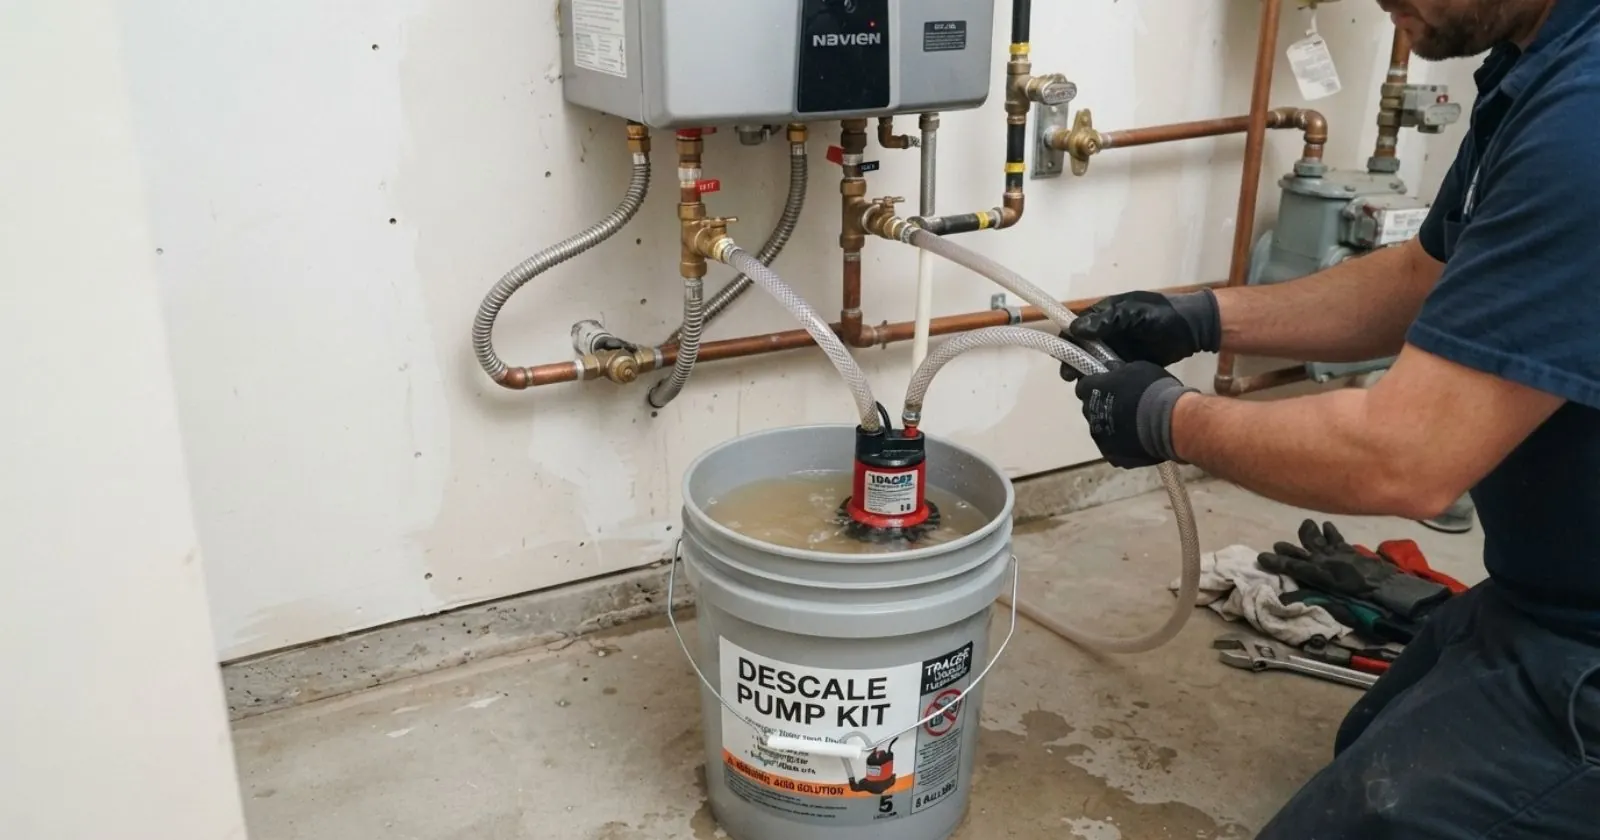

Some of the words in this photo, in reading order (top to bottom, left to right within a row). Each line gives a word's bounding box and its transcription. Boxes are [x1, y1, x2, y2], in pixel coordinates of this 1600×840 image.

[738, 656, 887, 700] DESCALE
[737, 682, 825, 725] PUMP
[837, 703, 891, 728] KIT
[879, 795, 893, 813] 5
